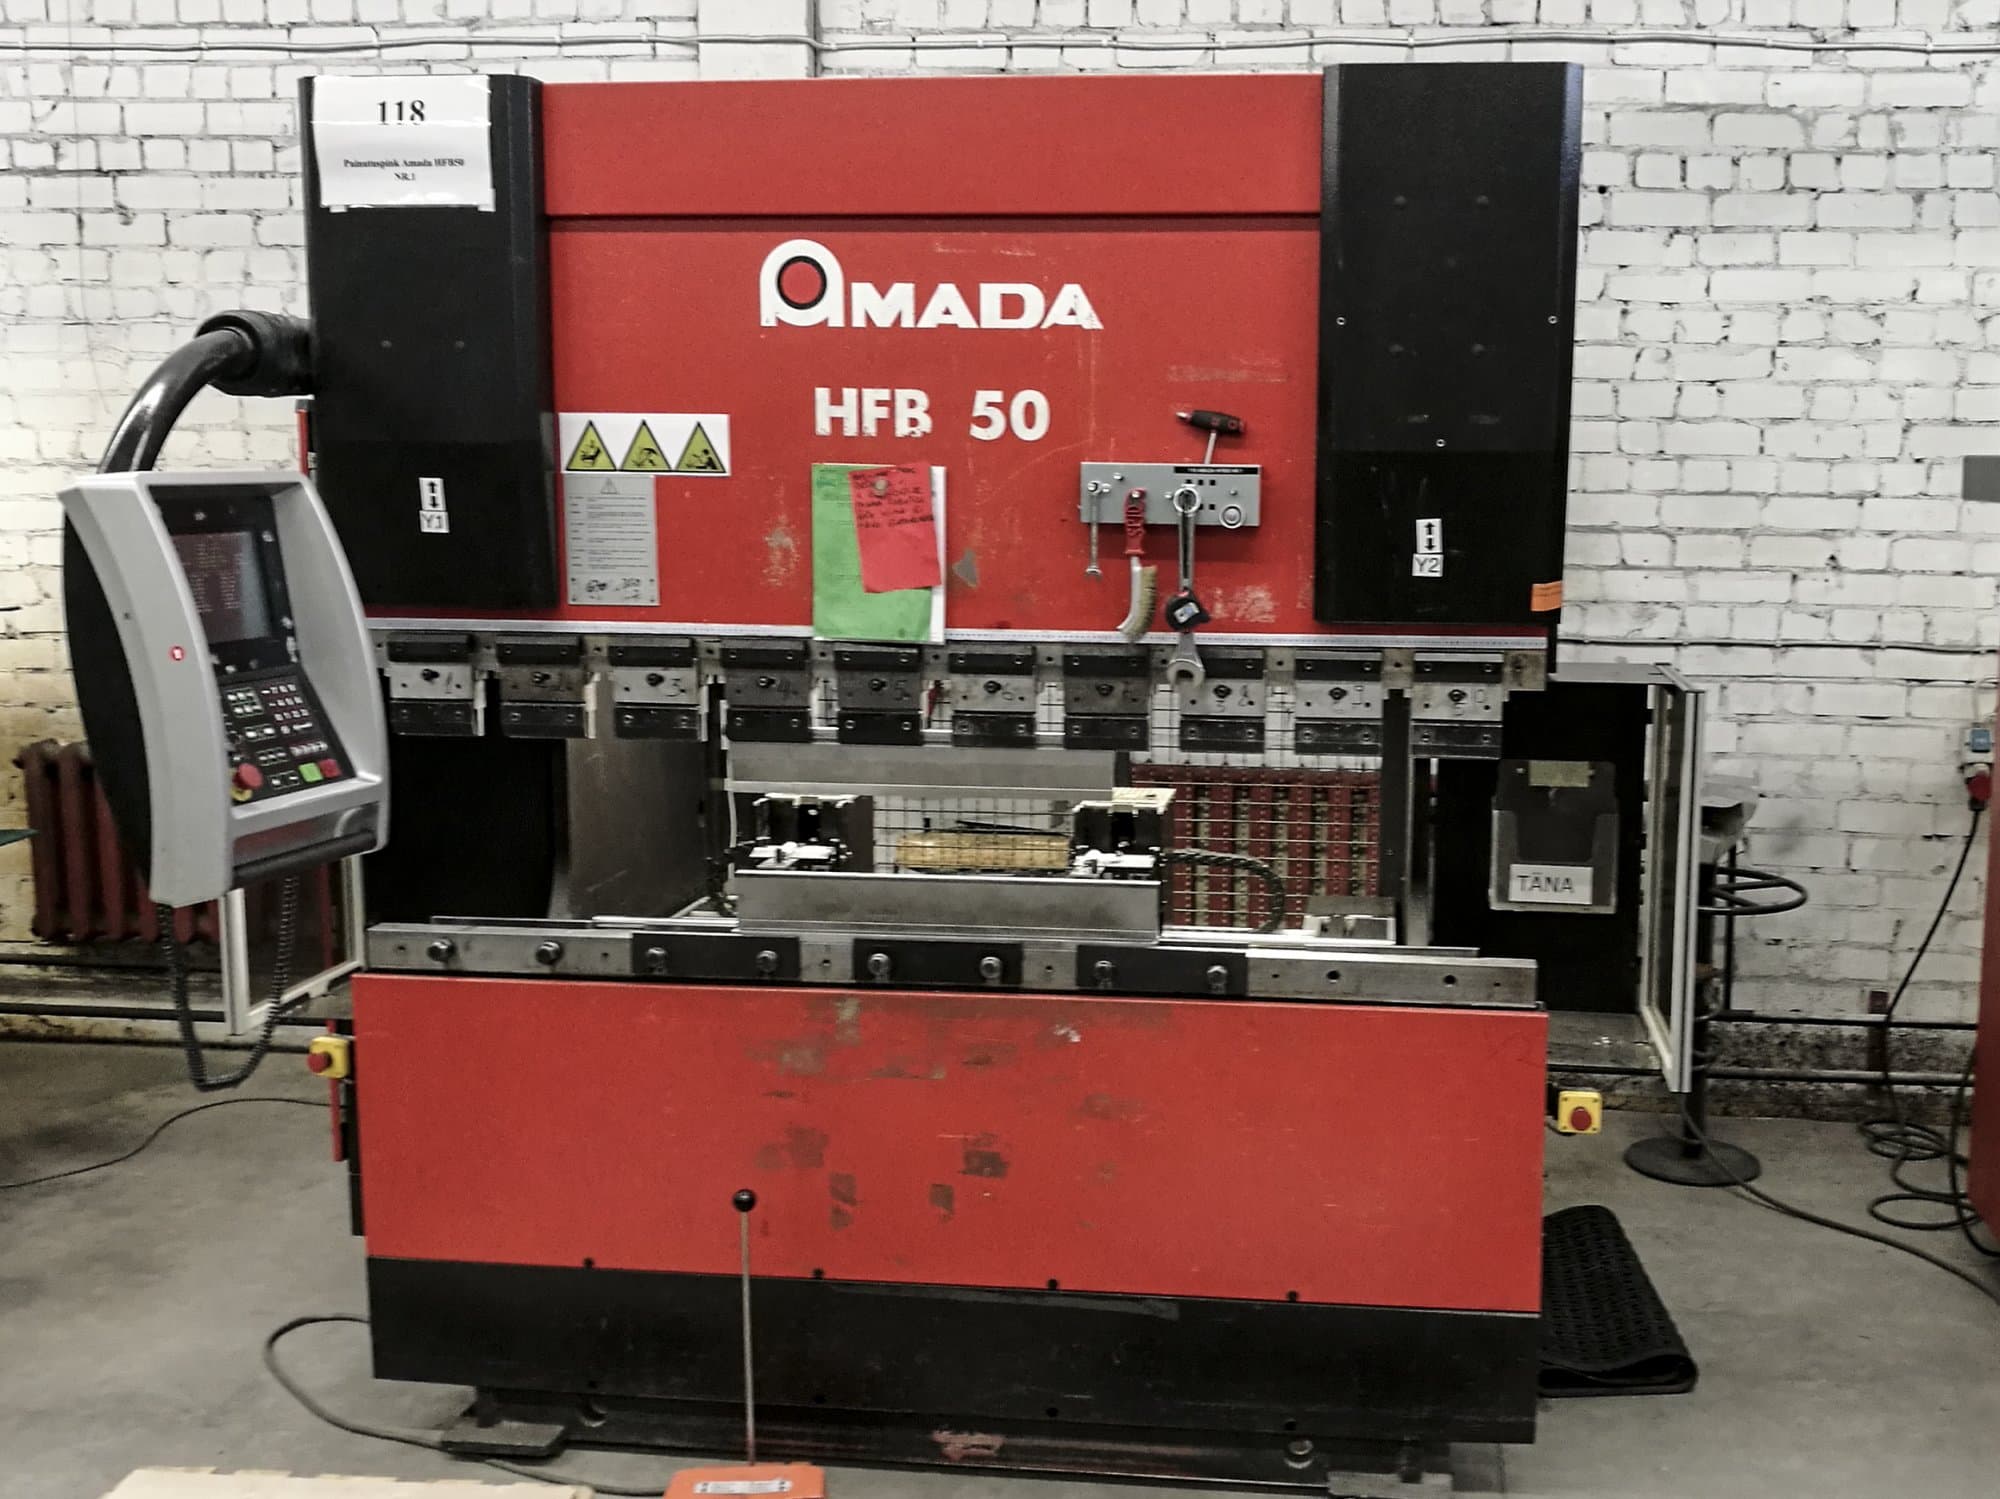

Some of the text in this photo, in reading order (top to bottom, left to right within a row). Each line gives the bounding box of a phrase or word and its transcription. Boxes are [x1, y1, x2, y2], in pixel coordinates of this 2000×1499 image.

[376, 98, 426, 126] 118
[402, 158, 433, 168] Amada
[434, 157, 465, 167] HFB50
[759, 239, 1104, 330] AMADA
[814, 387, 1051, 442] HFB 50
[421, 513, 443, 529] Y1
[1415, 557, 1442, 574] Y2
